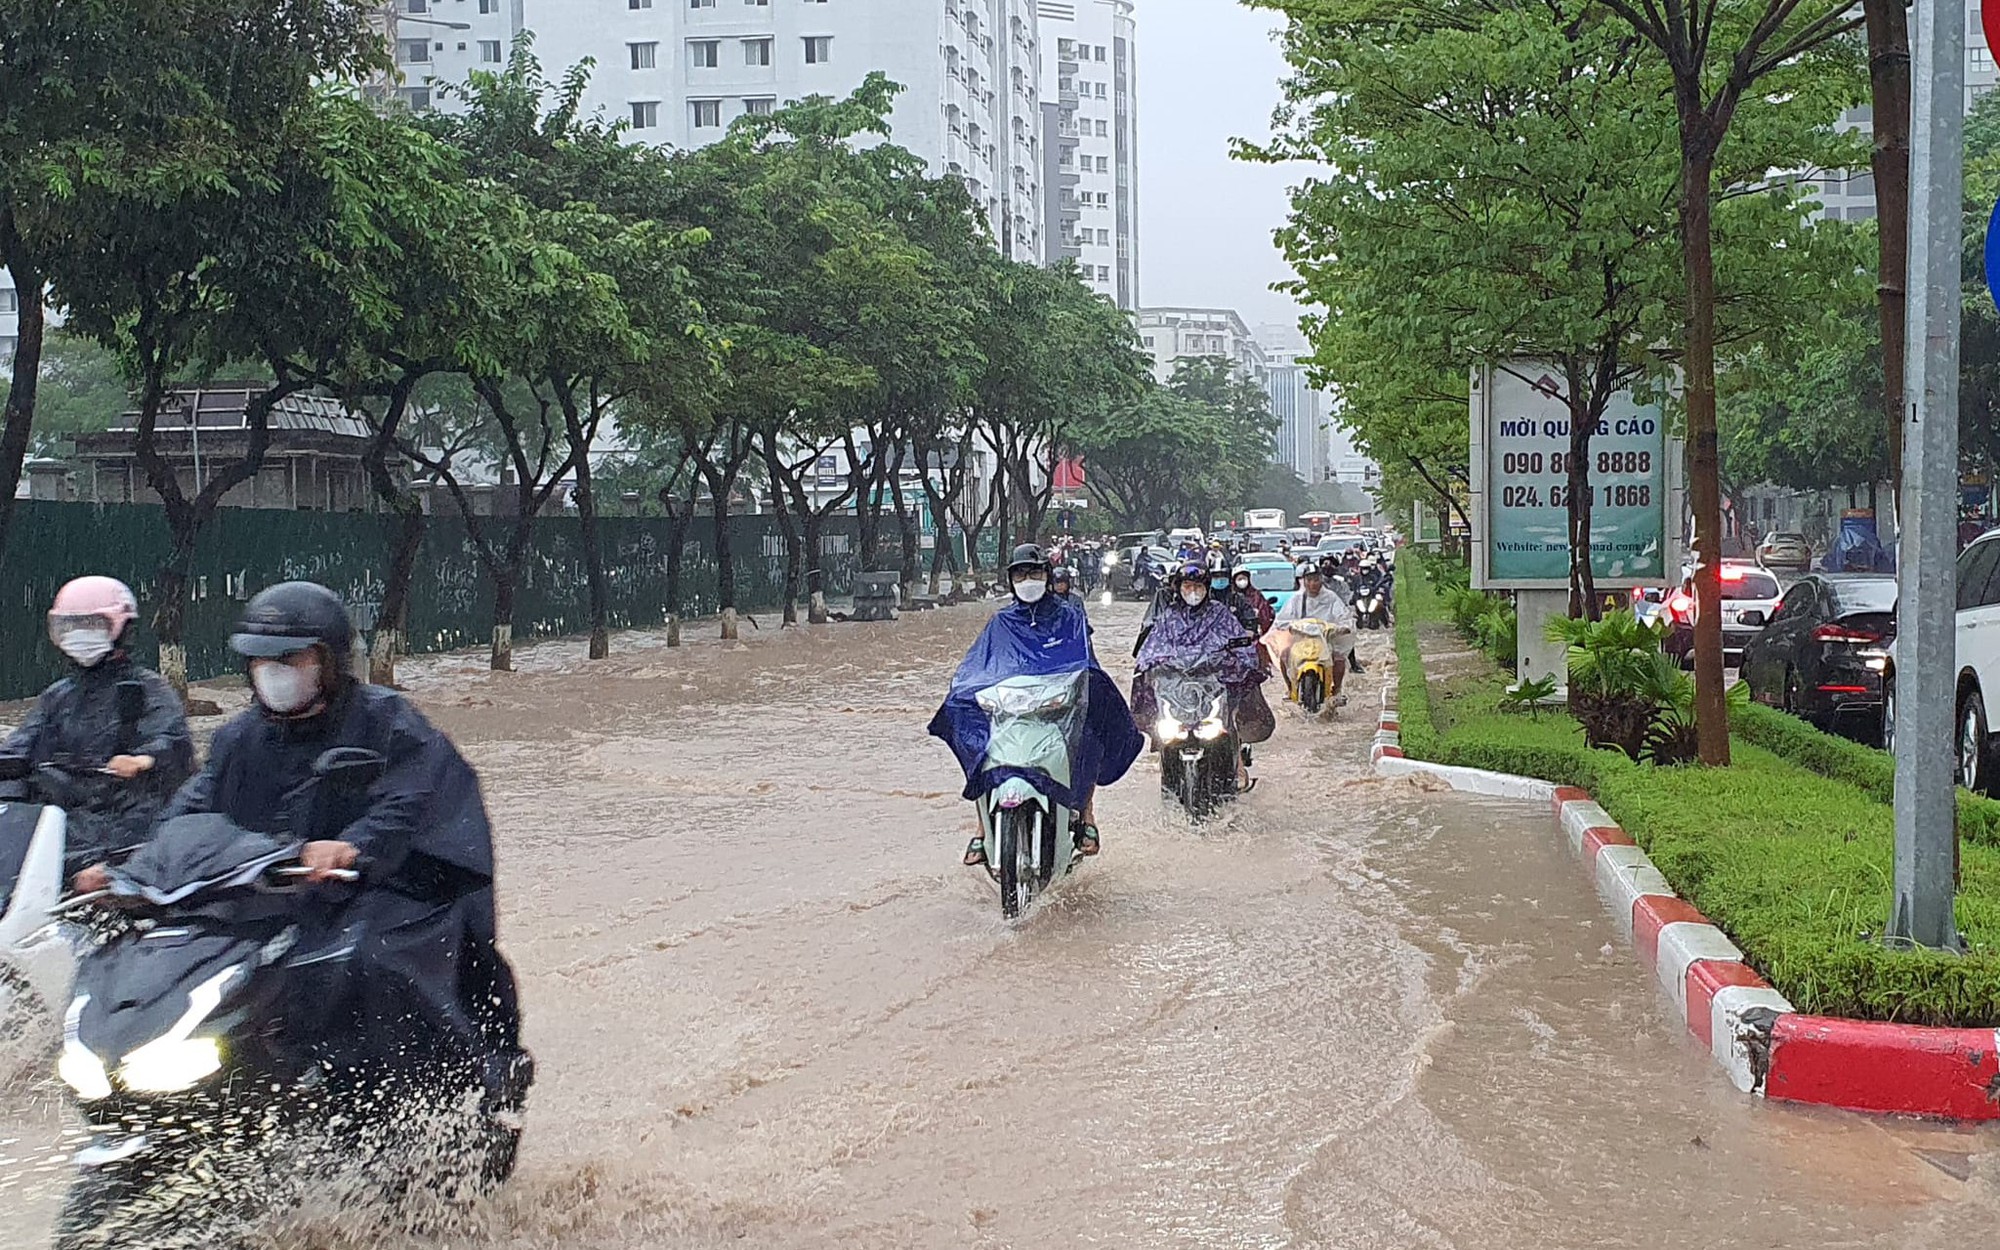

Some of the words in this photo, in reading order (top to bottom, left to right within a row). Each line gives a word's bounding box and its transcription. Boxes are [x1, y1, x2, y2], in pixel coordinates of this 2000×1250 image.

[1500, 416, 1536, 437] MỜI
[1543, 420, 1609, 439] QUG
[1615, 415, 1655, 436] CÁO
[1503, 452, 1543, 474] 090
[1597, 451, 1651, 473] 8888
[1503, 485, 1543, 507] 024.
[1550, 485, 1594, 507] 621
[1603, 485, 1650, 507] 1868
[1497, 541, 1542, 552] Website:
